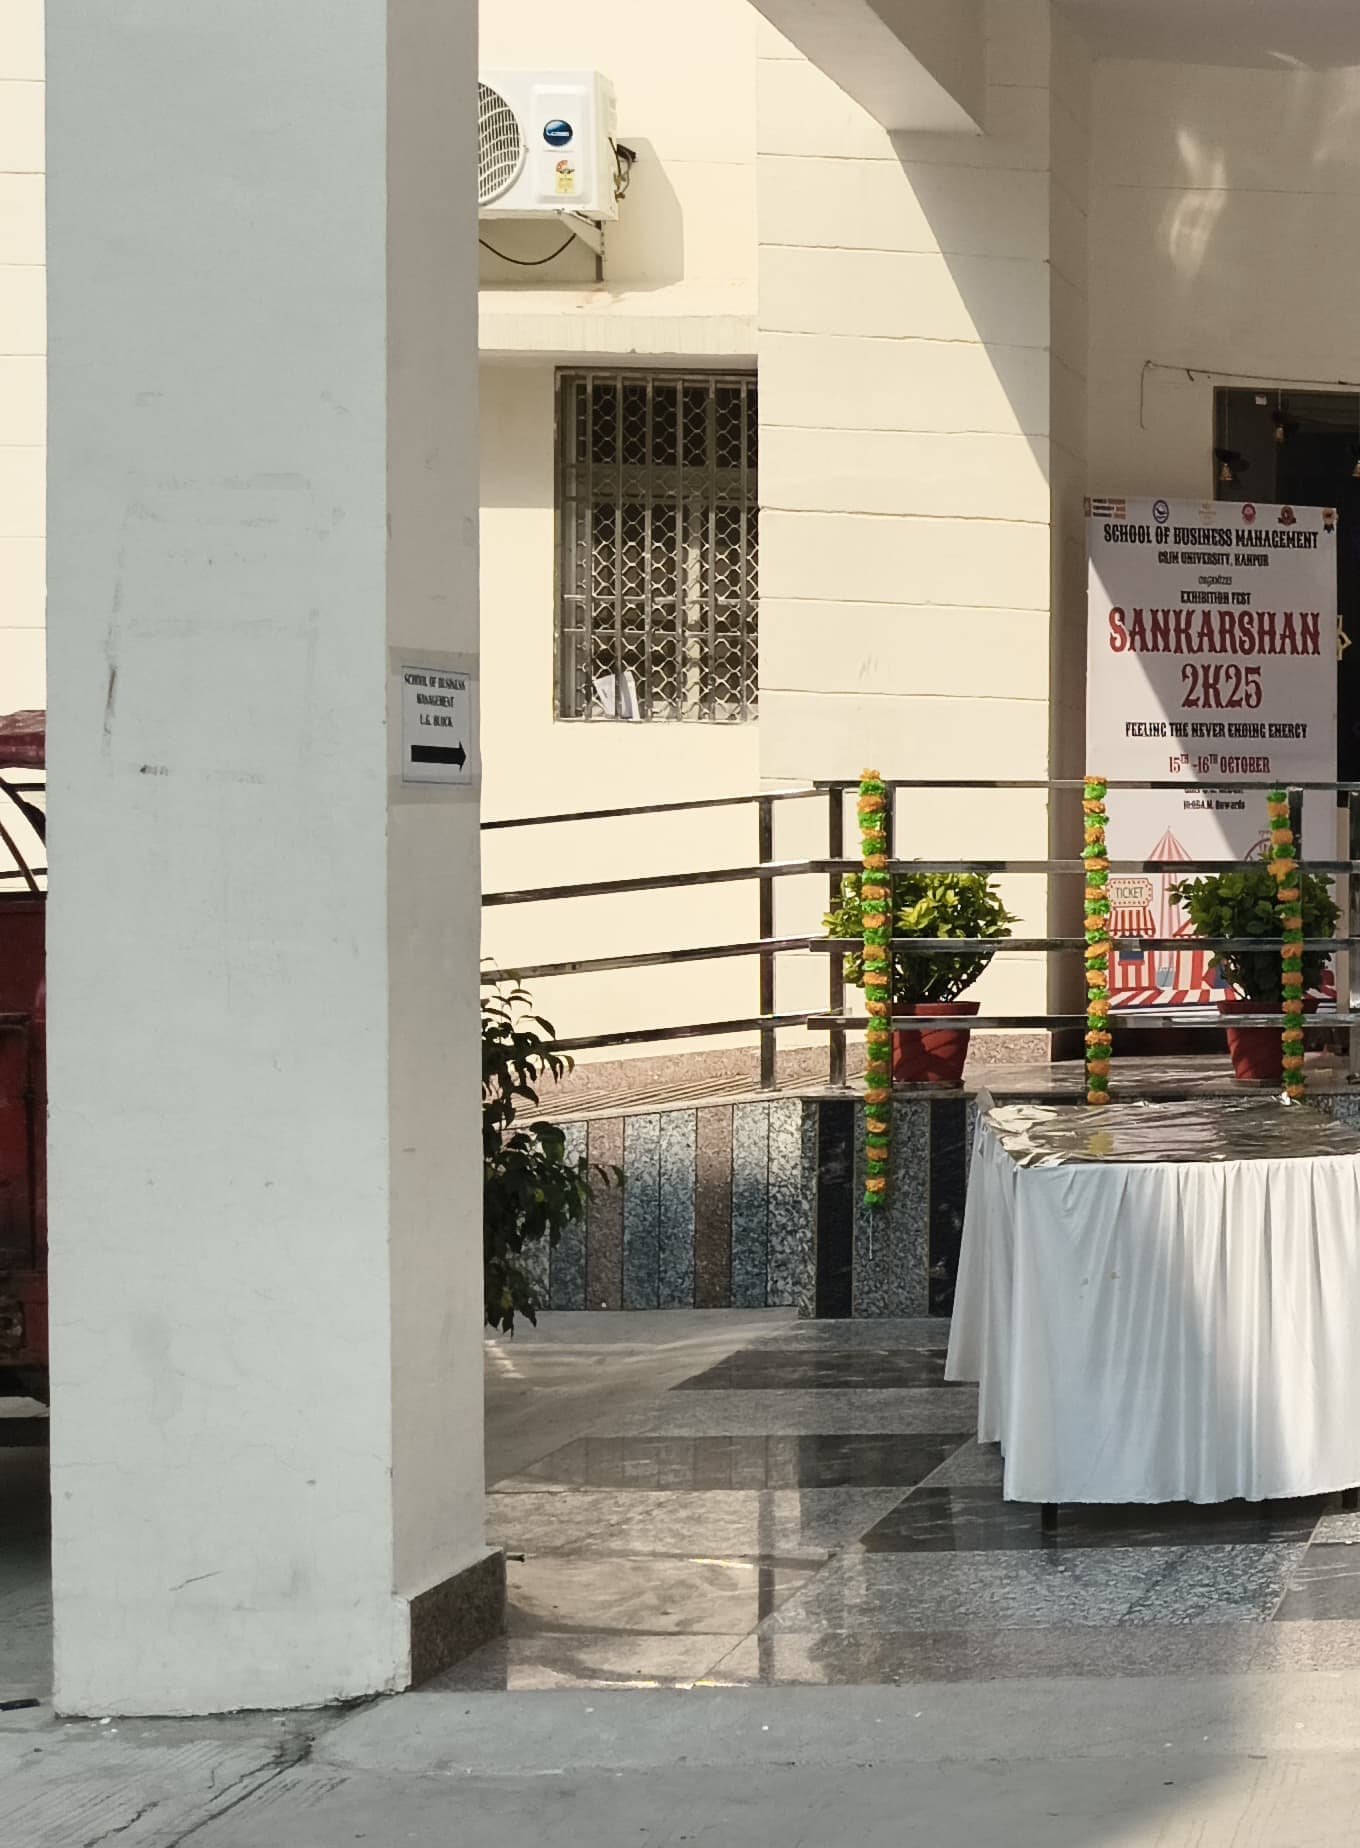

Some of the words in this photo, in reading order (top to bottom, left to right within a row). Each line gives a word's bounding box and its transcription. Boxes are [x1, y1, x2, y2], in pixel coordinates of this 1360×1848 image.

[1104, 523, 1152, 545] SCHOOL
[1155, 527, 1170, 545] OF
[1174, 527, 1232, 547] BUSINESS
[1235, 529, 1318, 549] MANAGEMENT
[1180, 590, 1229, 605] EXHIBITION
[1231, 591, 1251, 605] FEST
[1108, 606, 1321, 656] SANKARSHAN
[1181, 663, 1263, 709] 2K25
[1125, 722, 1167, 738] FEELING
[1169, 722, 1189, 738] THE
[1191, 722, 1225, 739] NEVER
[1228, 722, 1266, 739] ENDING
[1268, 723, 1307, 739] ENERGY
[1220, 756, 1270, 774] OCTOBER
[1116, 887, 1144, 899] TICKET
